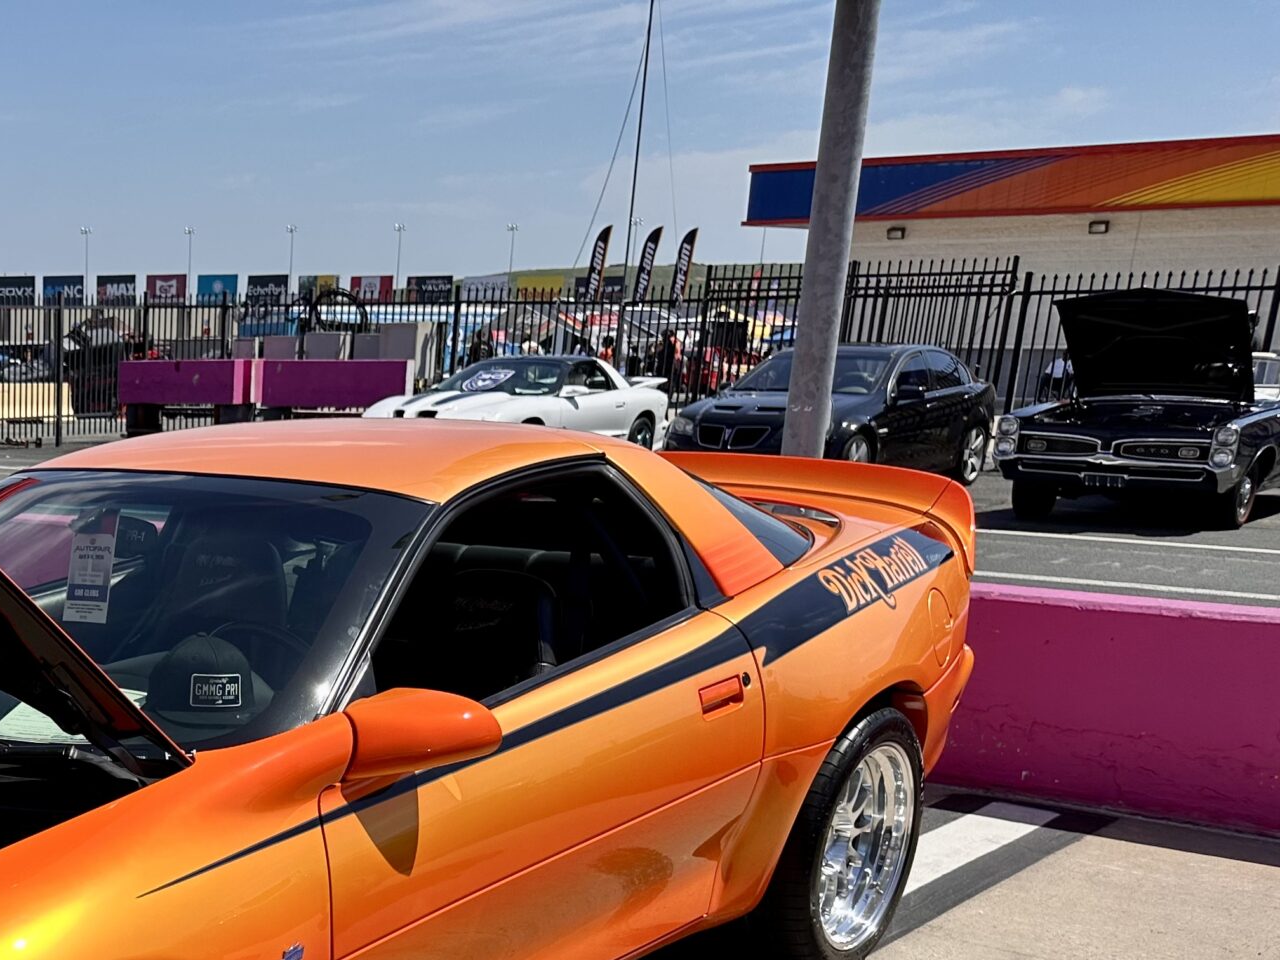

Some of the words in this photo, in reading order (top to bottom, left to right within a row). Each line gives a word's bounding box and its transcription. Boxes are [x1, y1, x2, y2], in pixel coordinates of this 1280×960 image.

[817, 548, 897, 614] Dick
[195, 683, 223, 696] GMMG
[225, 683, 238, 696] PR1
